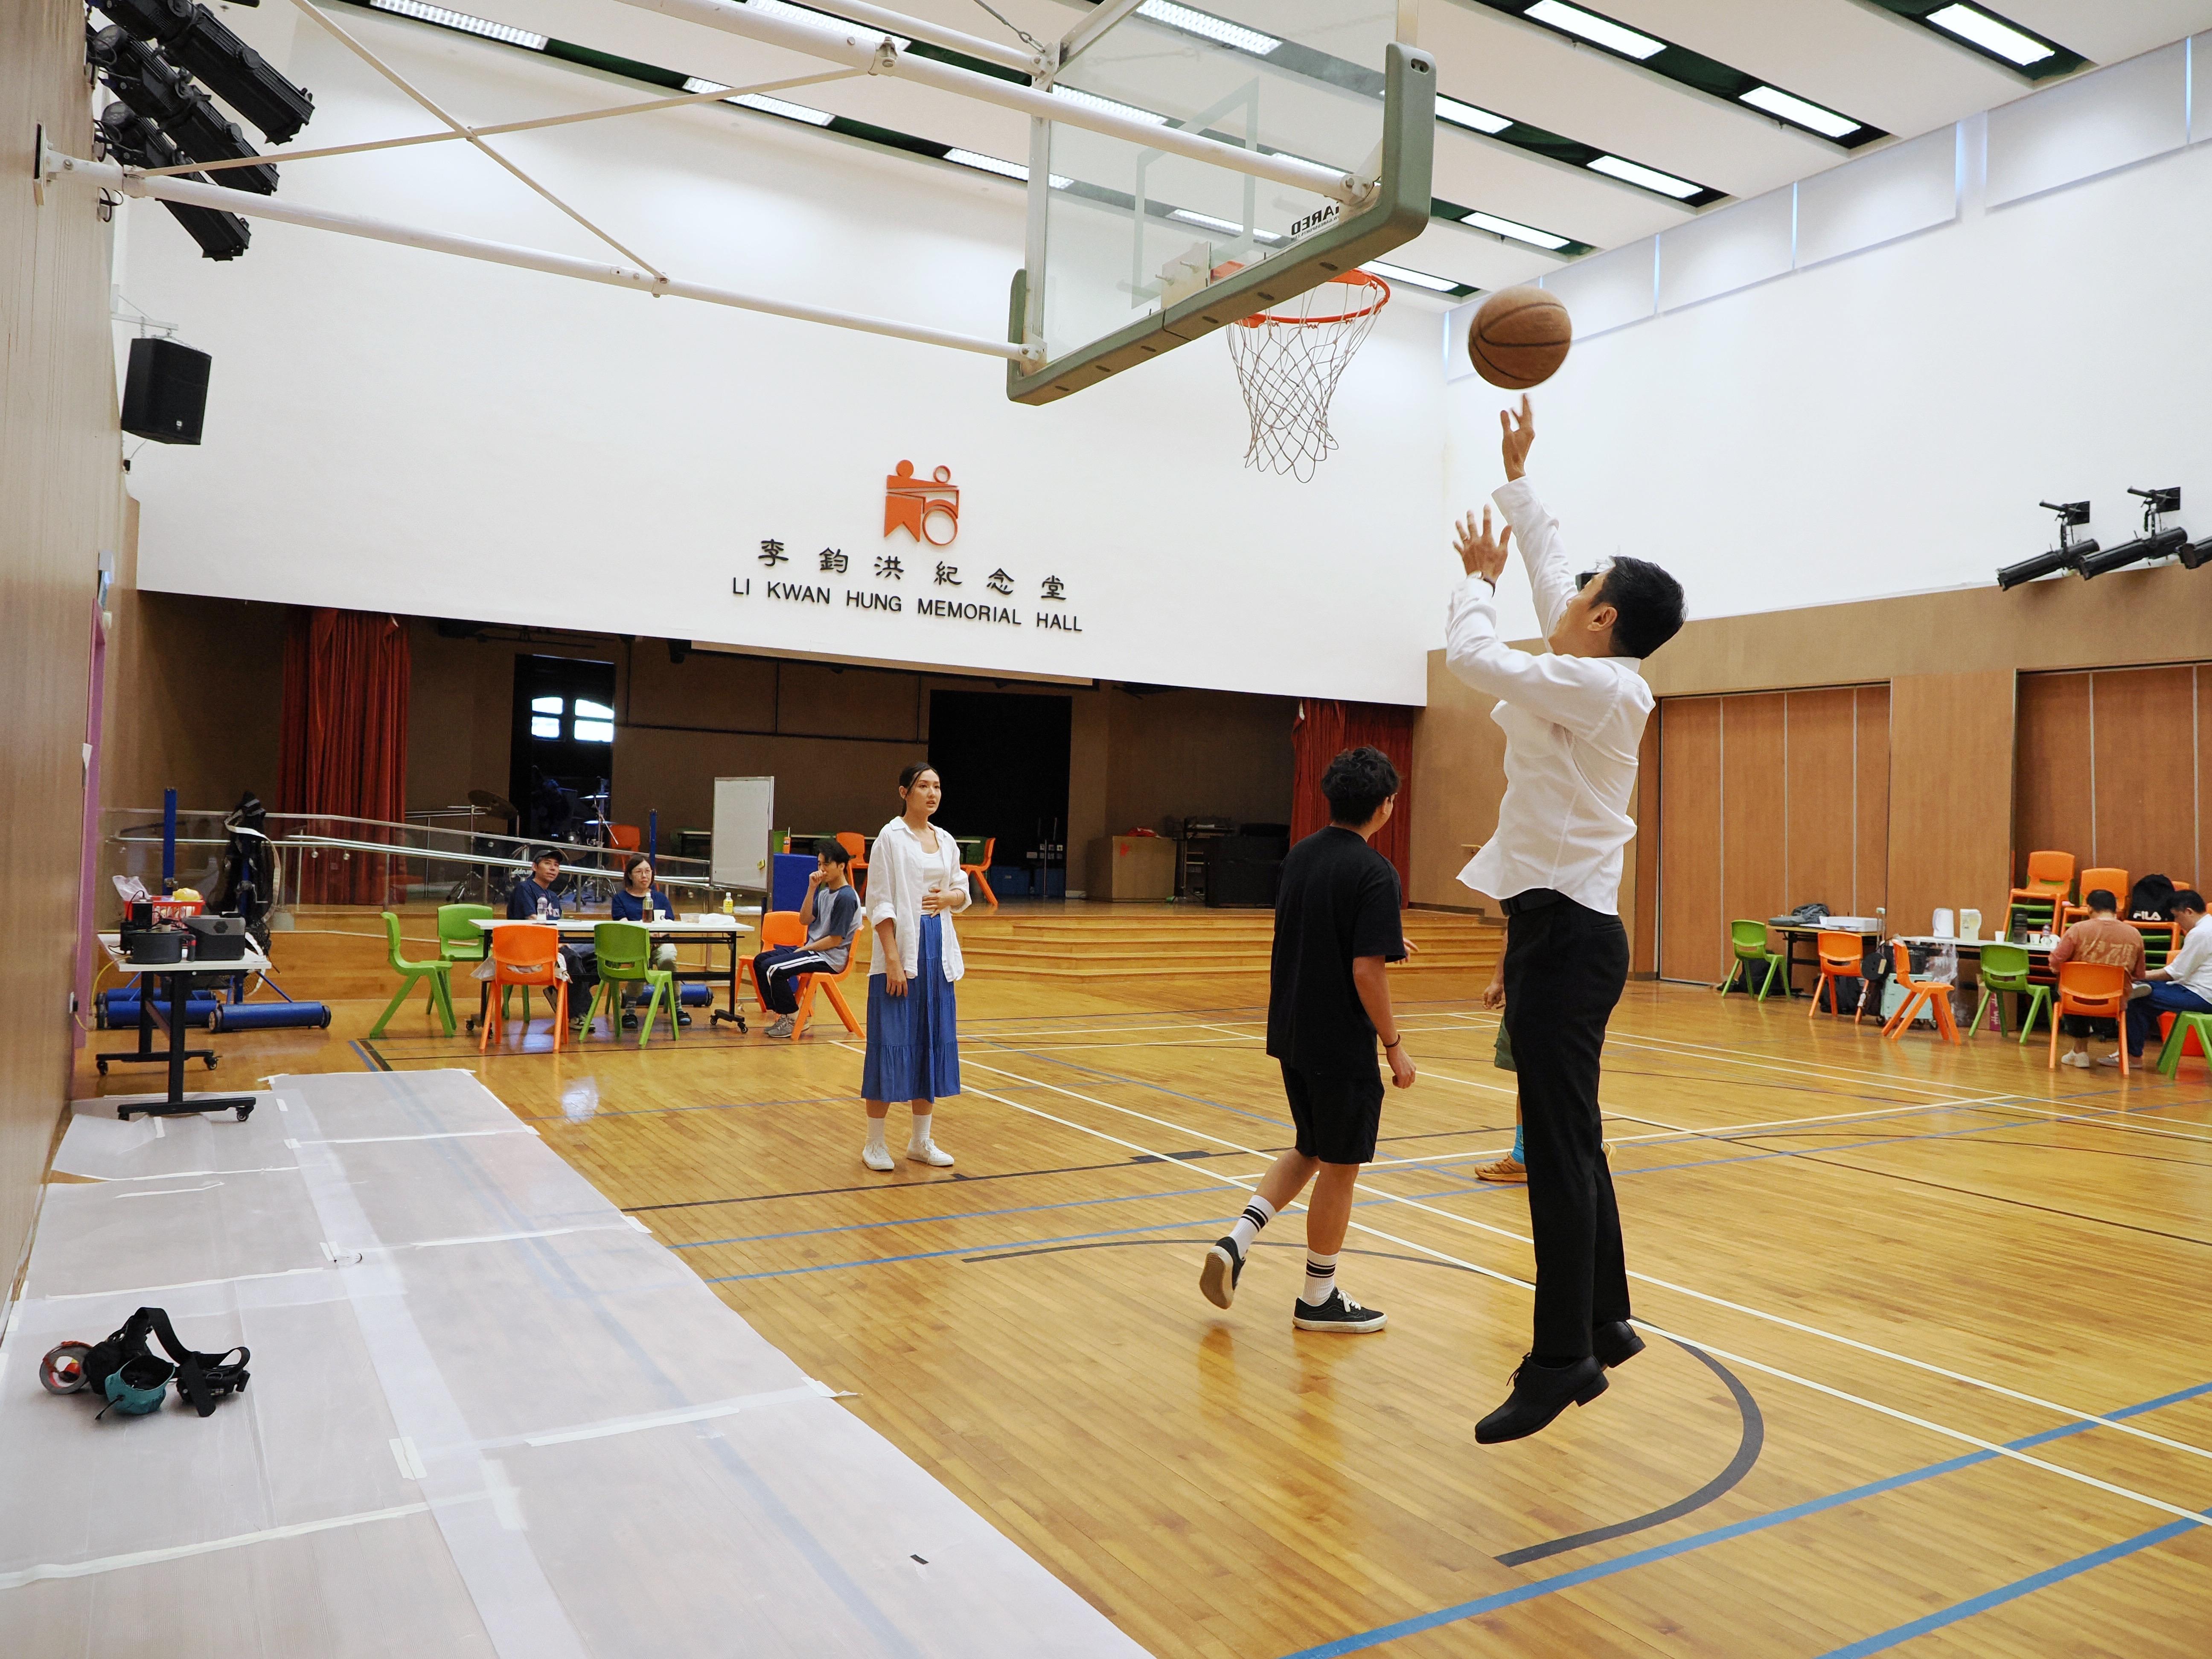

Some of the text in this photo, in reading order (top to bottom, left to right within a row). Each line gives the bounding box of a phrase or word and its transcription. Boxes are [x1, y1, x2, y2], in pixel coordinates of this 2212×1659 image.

[758, 538, 1067, 600] 李鈞洪紀念堂
[733, 577, 1083, 632] LI KWAN HUNG MEMORIAL HALL
[2133, 910, 2162, 921] FILA
